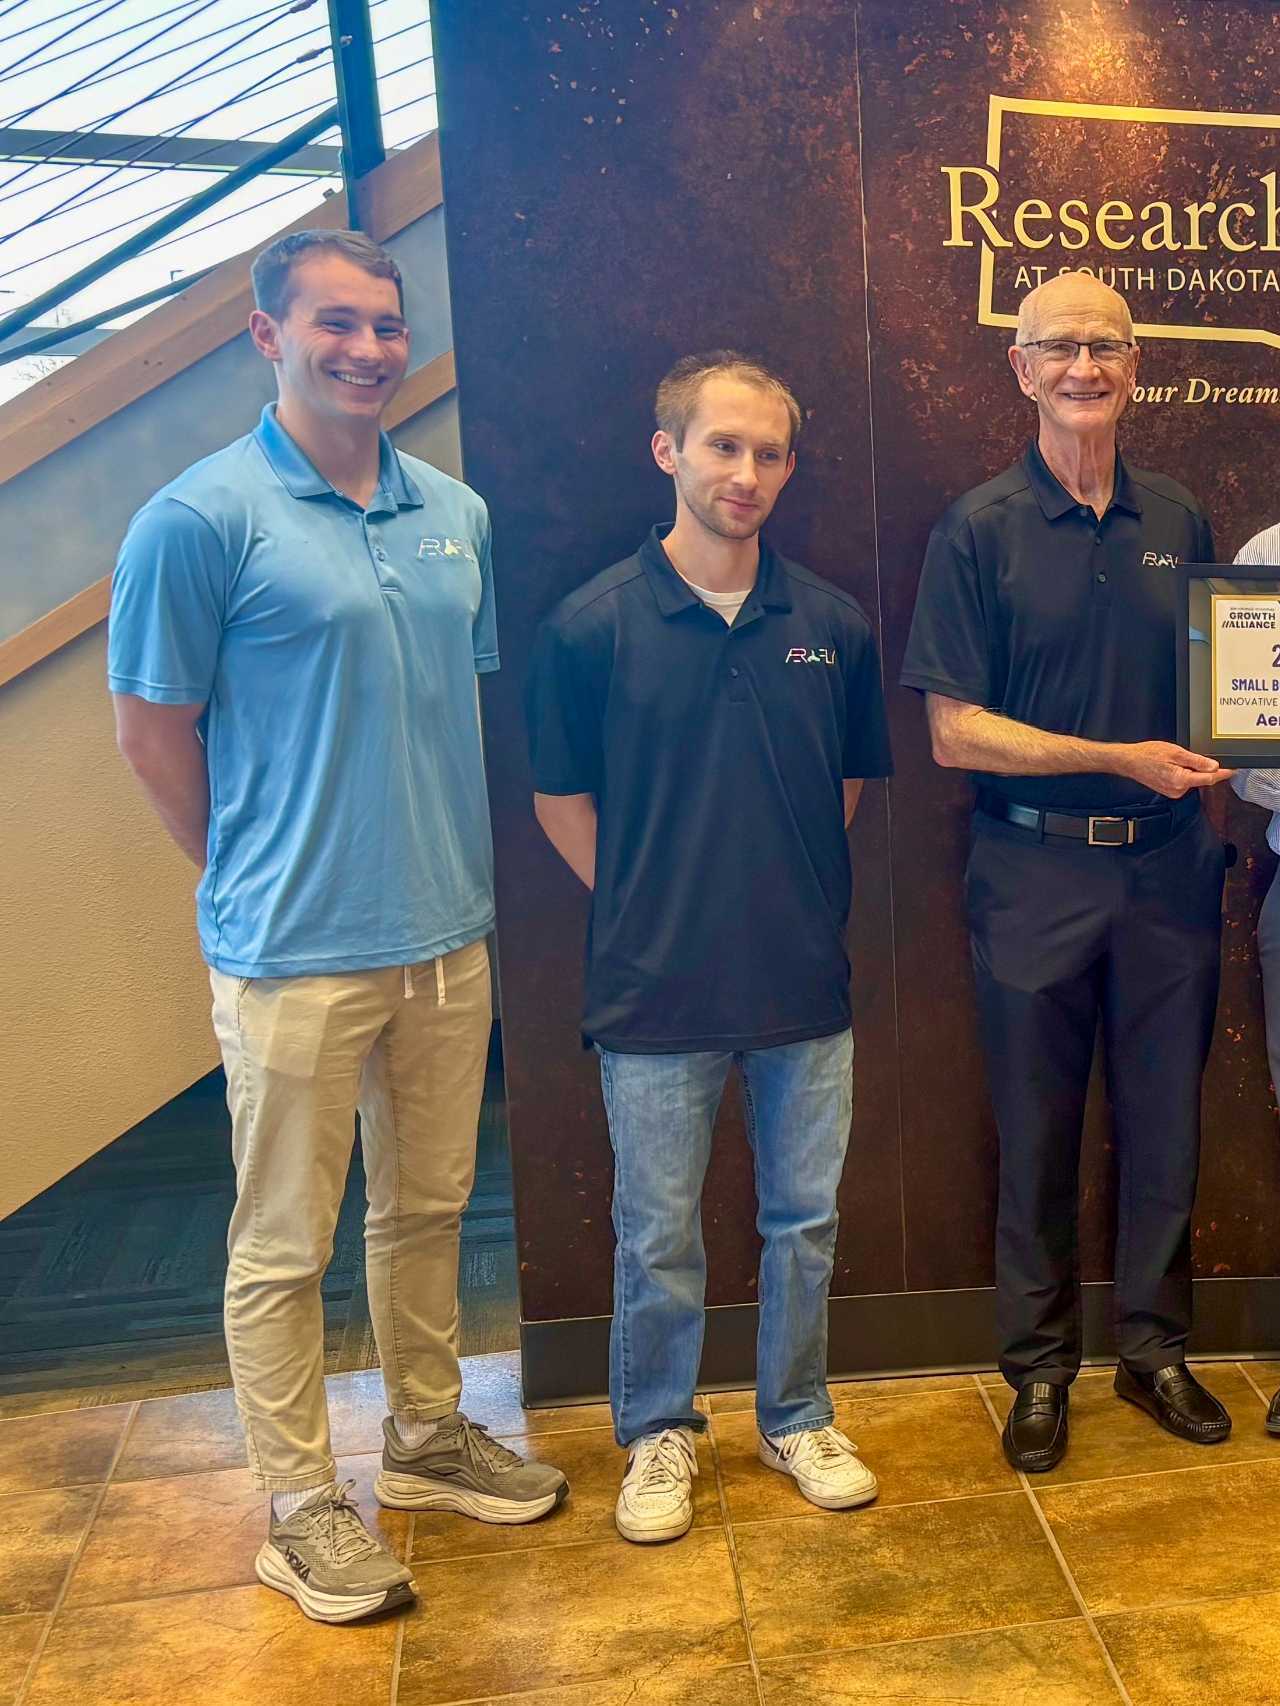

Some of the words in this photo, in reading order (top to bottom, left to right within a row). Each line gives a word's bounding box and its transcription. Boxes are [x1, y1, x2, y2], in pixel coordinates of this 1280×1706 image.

[1014, 265, 1048, 288] AT
[1167, 267, 1280, 293] DAKOTA
[1132, 386, 1178, 403] our
[1229, 612, 1276, 621] GROWTH
[1231, 678, 1269, 692] SMALL
[1219, 697, 1278, 707] INNOVATIVE
